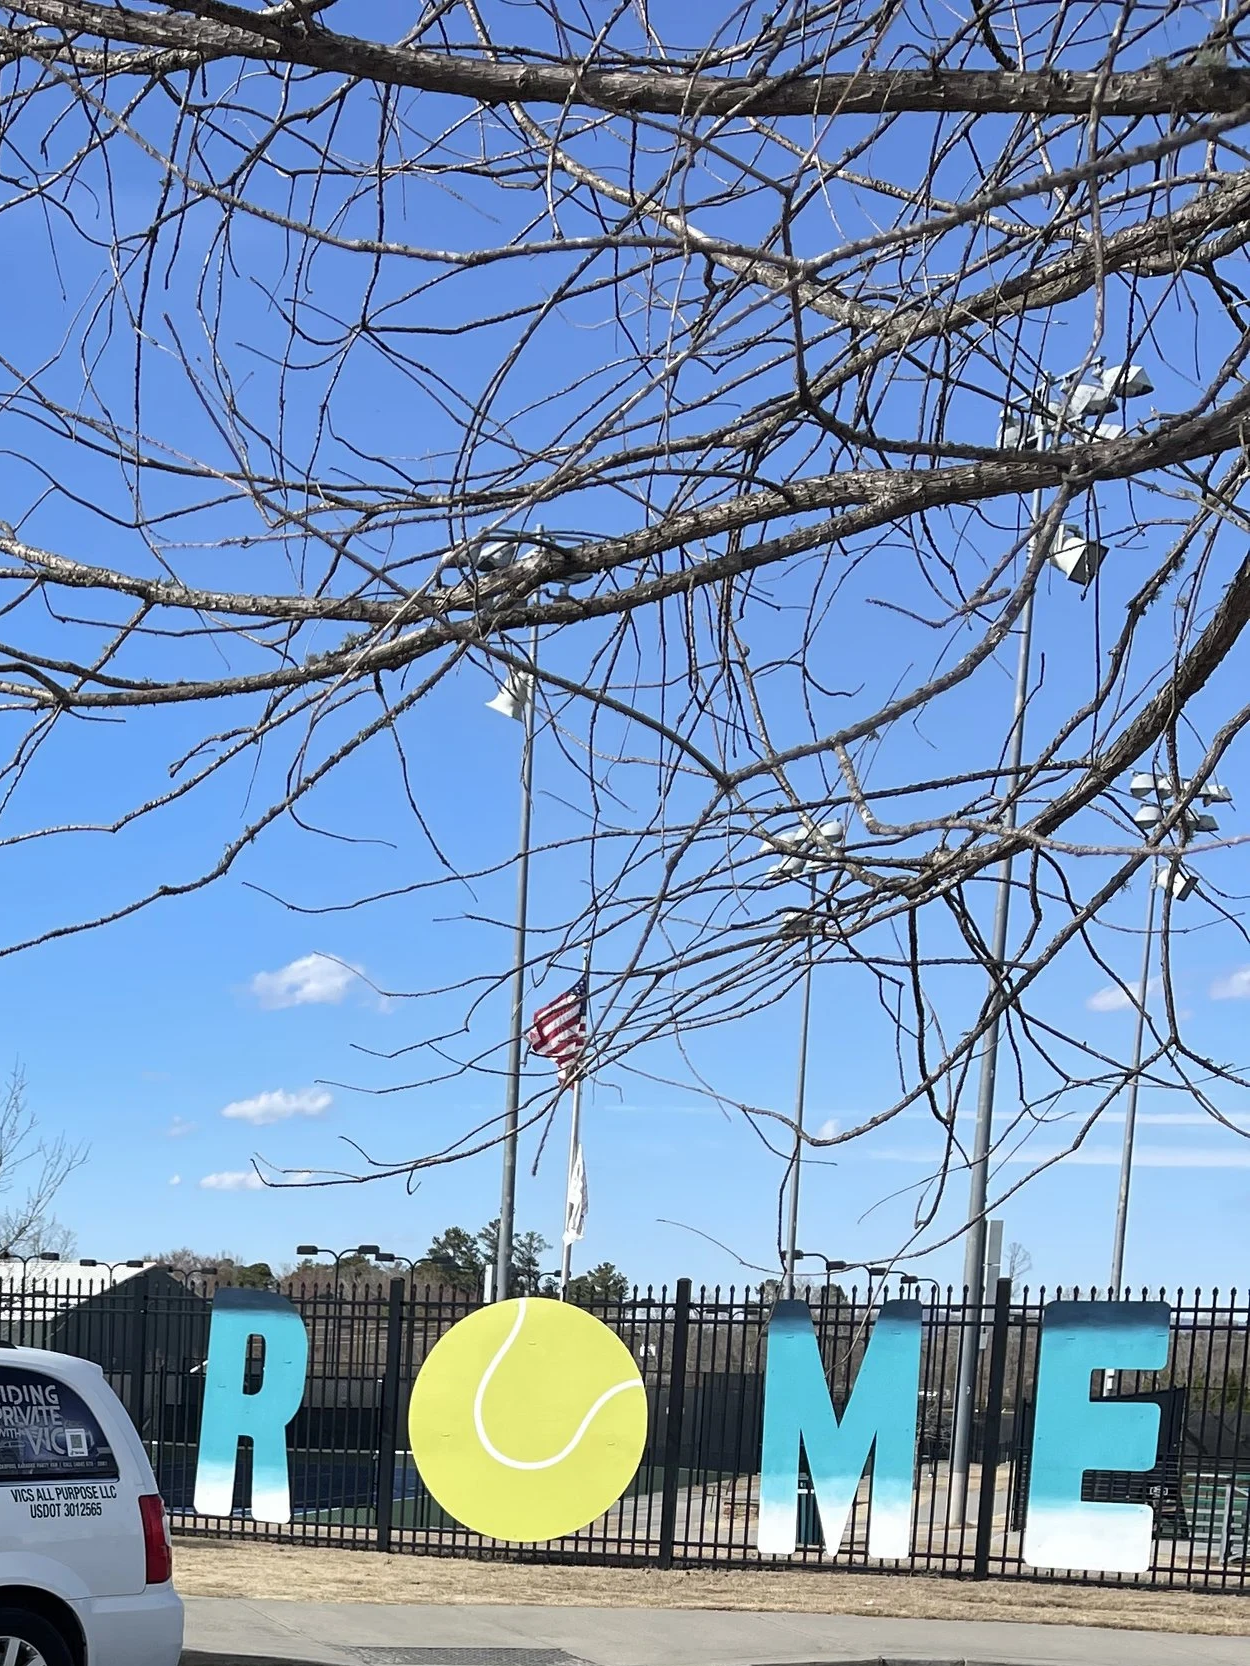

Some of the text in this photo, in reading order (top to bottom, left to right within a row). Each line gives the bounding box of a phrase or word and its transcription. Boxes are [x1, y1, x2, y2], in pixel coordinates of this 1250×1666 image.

[11, 1485, 117, 1503] VICS ALL PURPOSE LLC
[30, 1502, 102, 1519] USDOT 3012565
